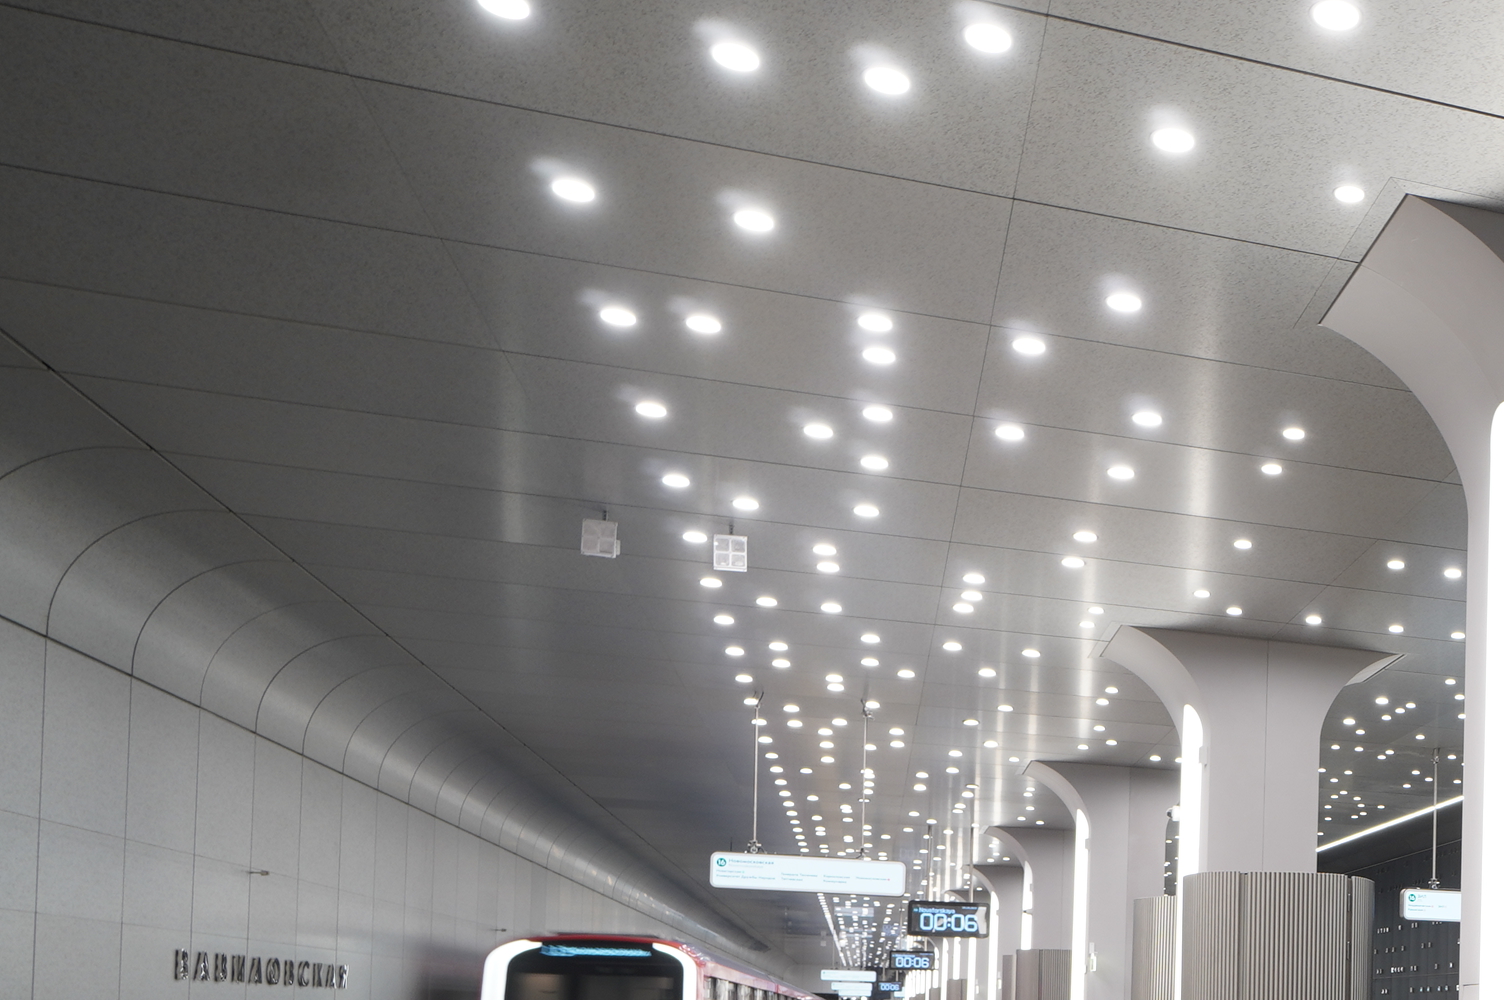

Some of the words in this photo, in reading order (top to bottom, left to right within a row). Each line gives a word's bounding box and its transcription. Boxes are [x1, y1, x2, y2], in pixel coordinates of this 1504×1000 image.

[919, 913, 978, 932] 00:06
[173, 948, 349, 990] ВАВИЛОВСКАЯ
[895, 957, 930, 968] 00:06
